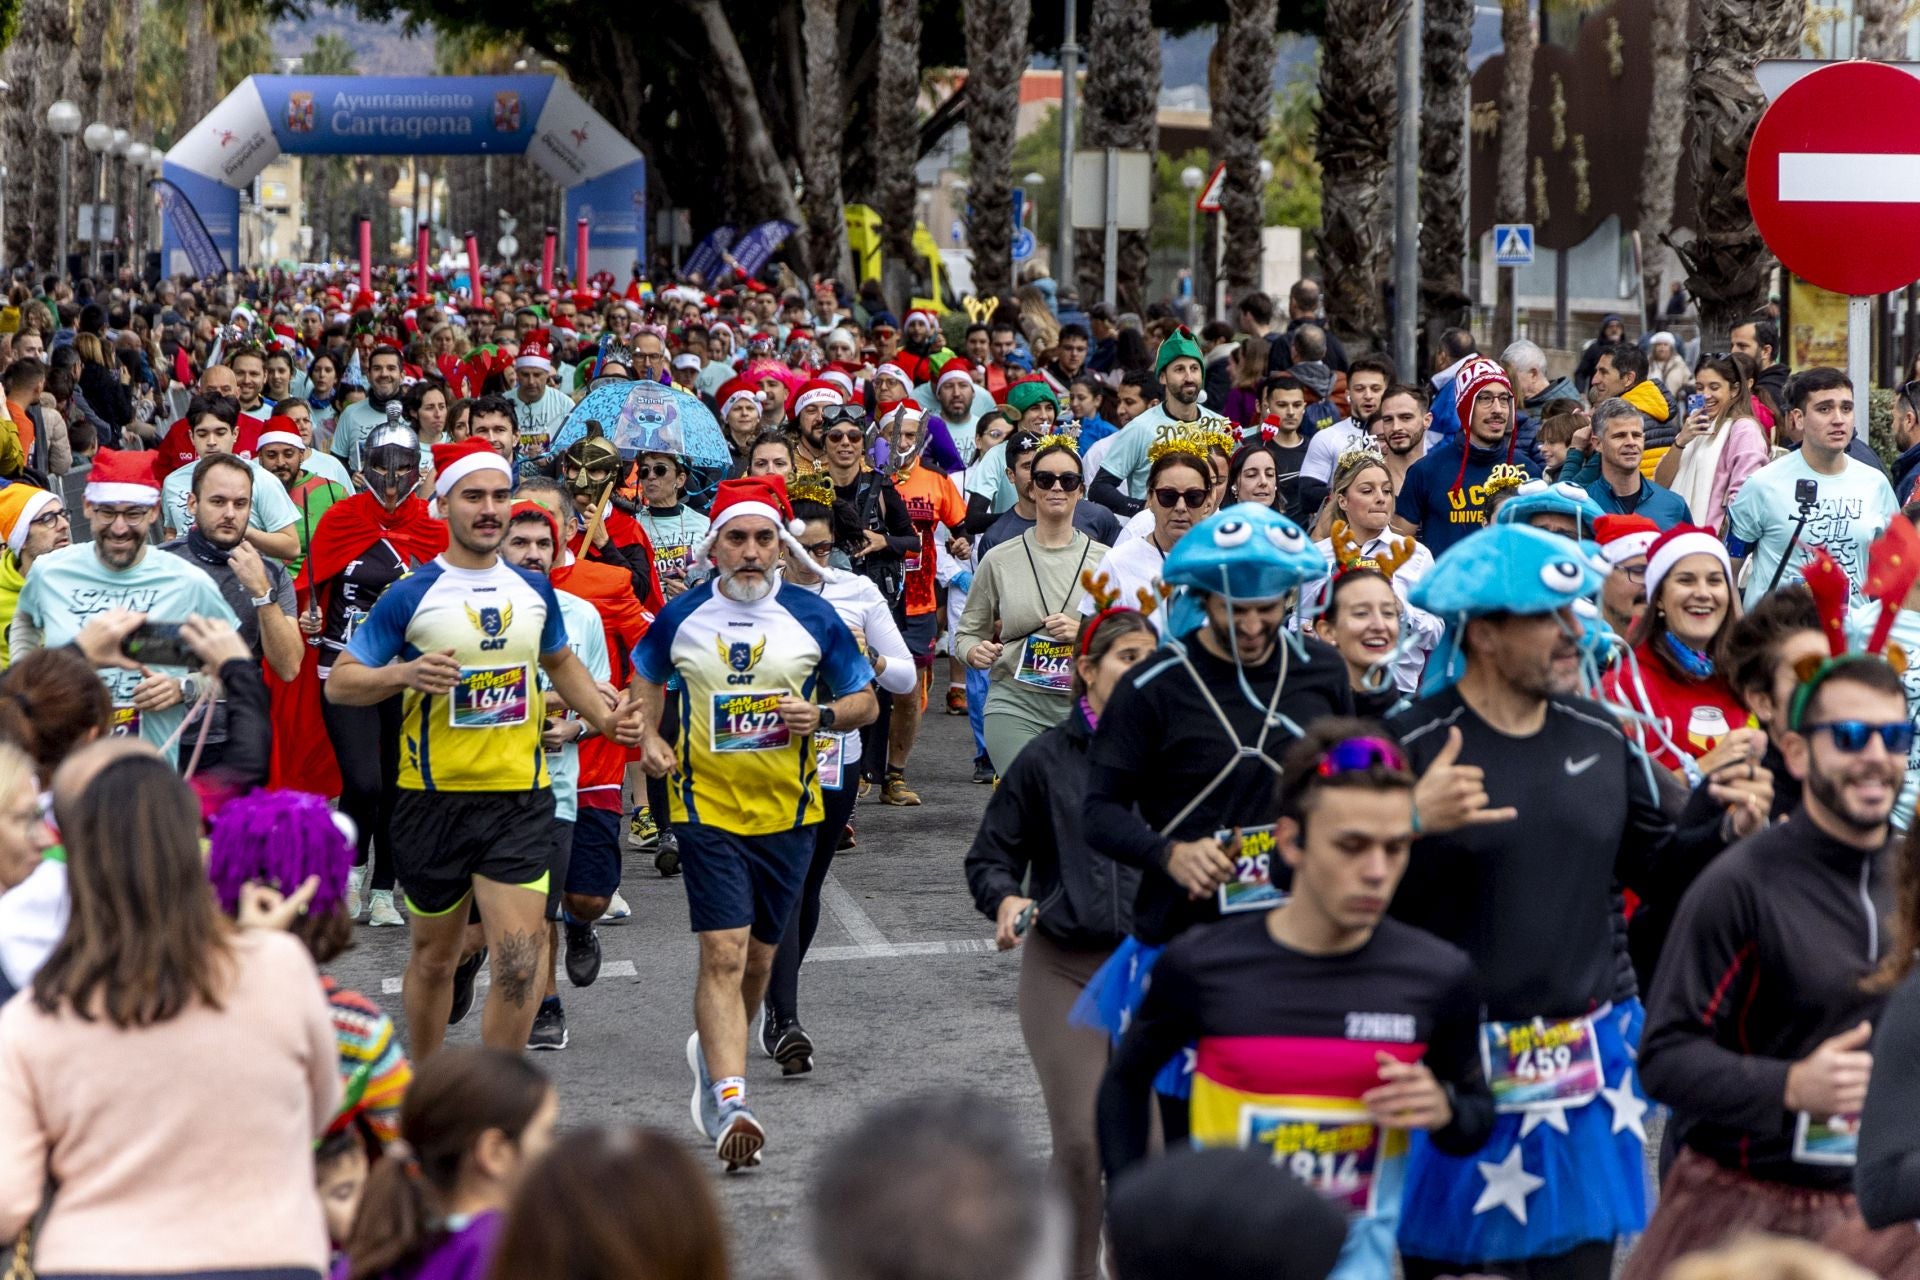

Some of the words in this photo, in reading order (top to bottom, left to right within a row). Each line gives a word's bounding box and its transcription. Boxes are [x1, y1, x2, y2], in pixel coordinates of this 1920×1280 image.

[333, 91, 474, 112] Ayuntamiento
[331, 110, 472, 139] Cartagena
[1448, 485, 1485, 510] UC
[1450, 511, 1484, 523] UNIVE
[480, 638, 508, 651] CAT
[1034, 641, 1050, 649] SAN
[1032, 654, 1070, 674] 1266
[470, 671, 495, 684] SAN
[470, 668, 522, 691] SILVESTRE
[727, 673, 755, 685] CAT
[467, 686, 518, 709] 1674
[729, 696, 752, 708] SAN
[729, 694, 782, 715] SILVESTR
[727, 712, 779, 734] 1672
[1236, 854, 1271, 884] 29
[1515, 1045, 1572, 1079] 459
